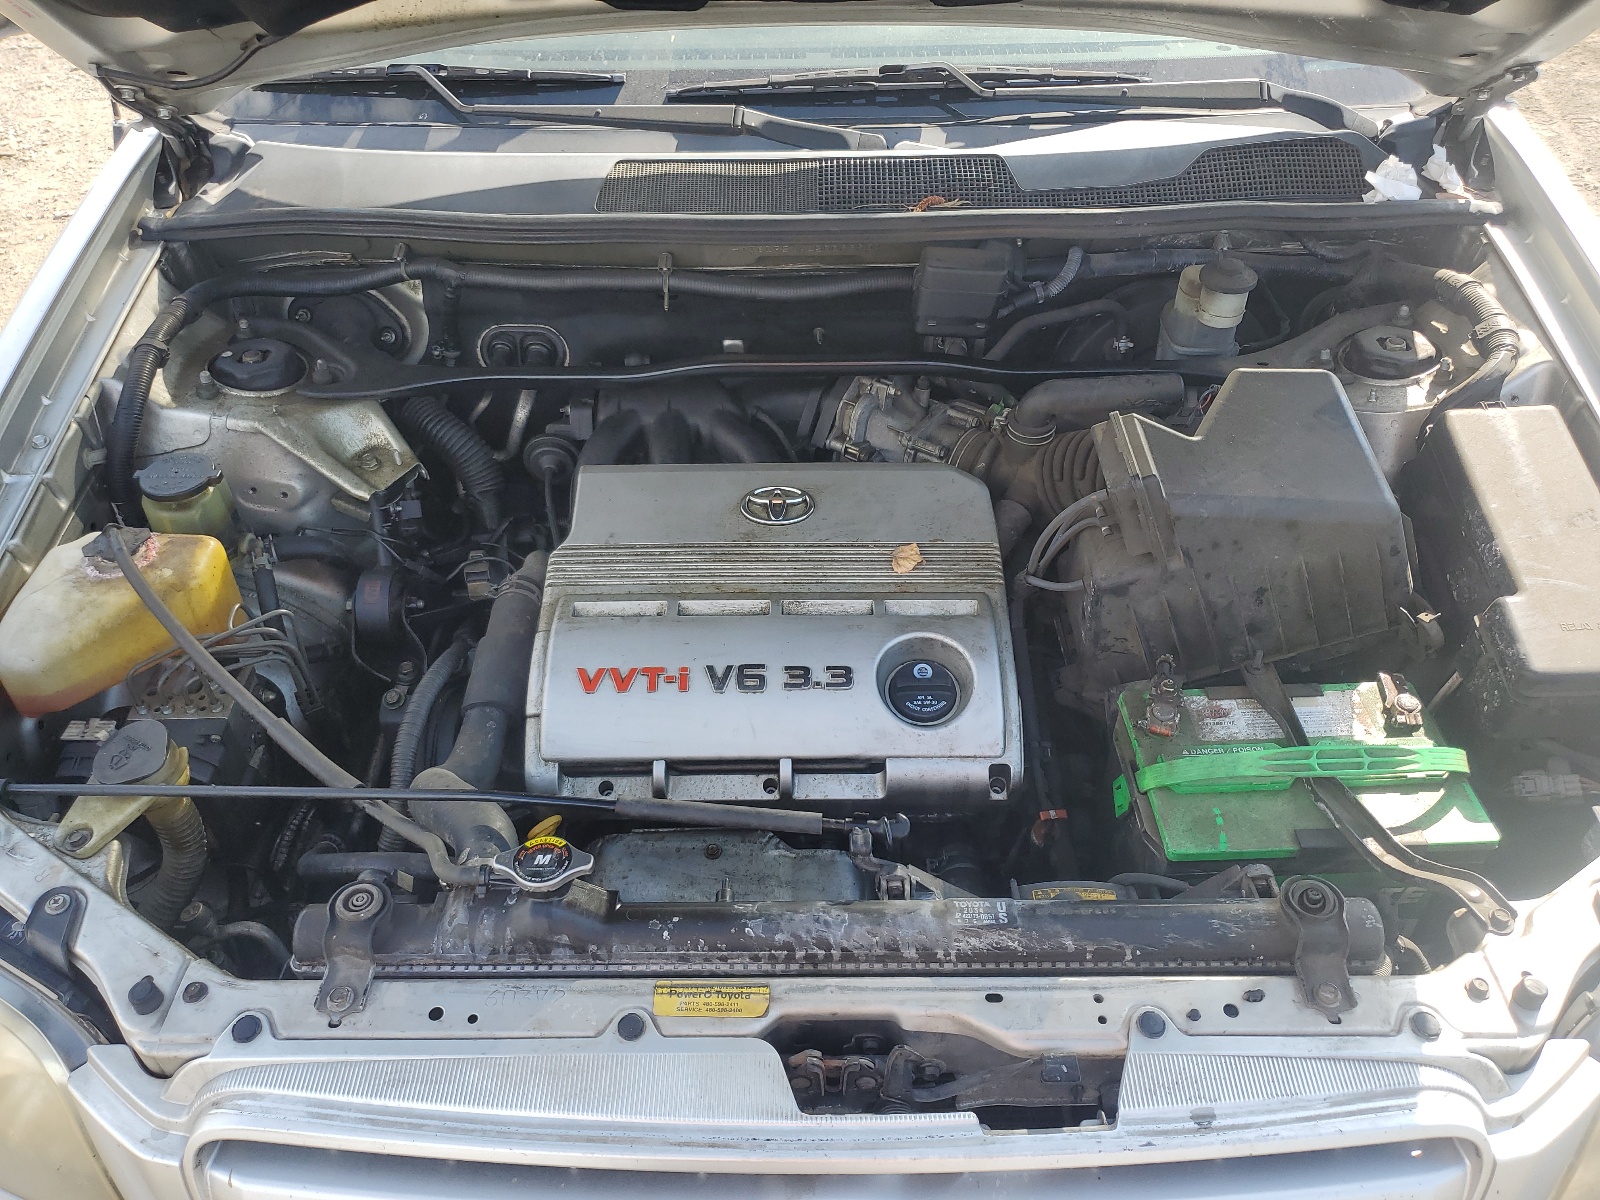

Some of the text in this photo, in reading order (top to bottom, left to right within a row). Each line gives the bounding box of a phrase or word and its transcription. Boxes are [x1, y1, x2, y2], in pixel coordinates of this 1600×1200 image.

[576, 663, 854, 694] VVT-i V6 3.3
[1232, 746, 1264, 754] POISON
[534, 836, 564, 846] CAUTION
[534, 854, 552, 865] M
[953, 900, 991, 908] TOYOTA
[715, 990, 751, 1001] Toyota
